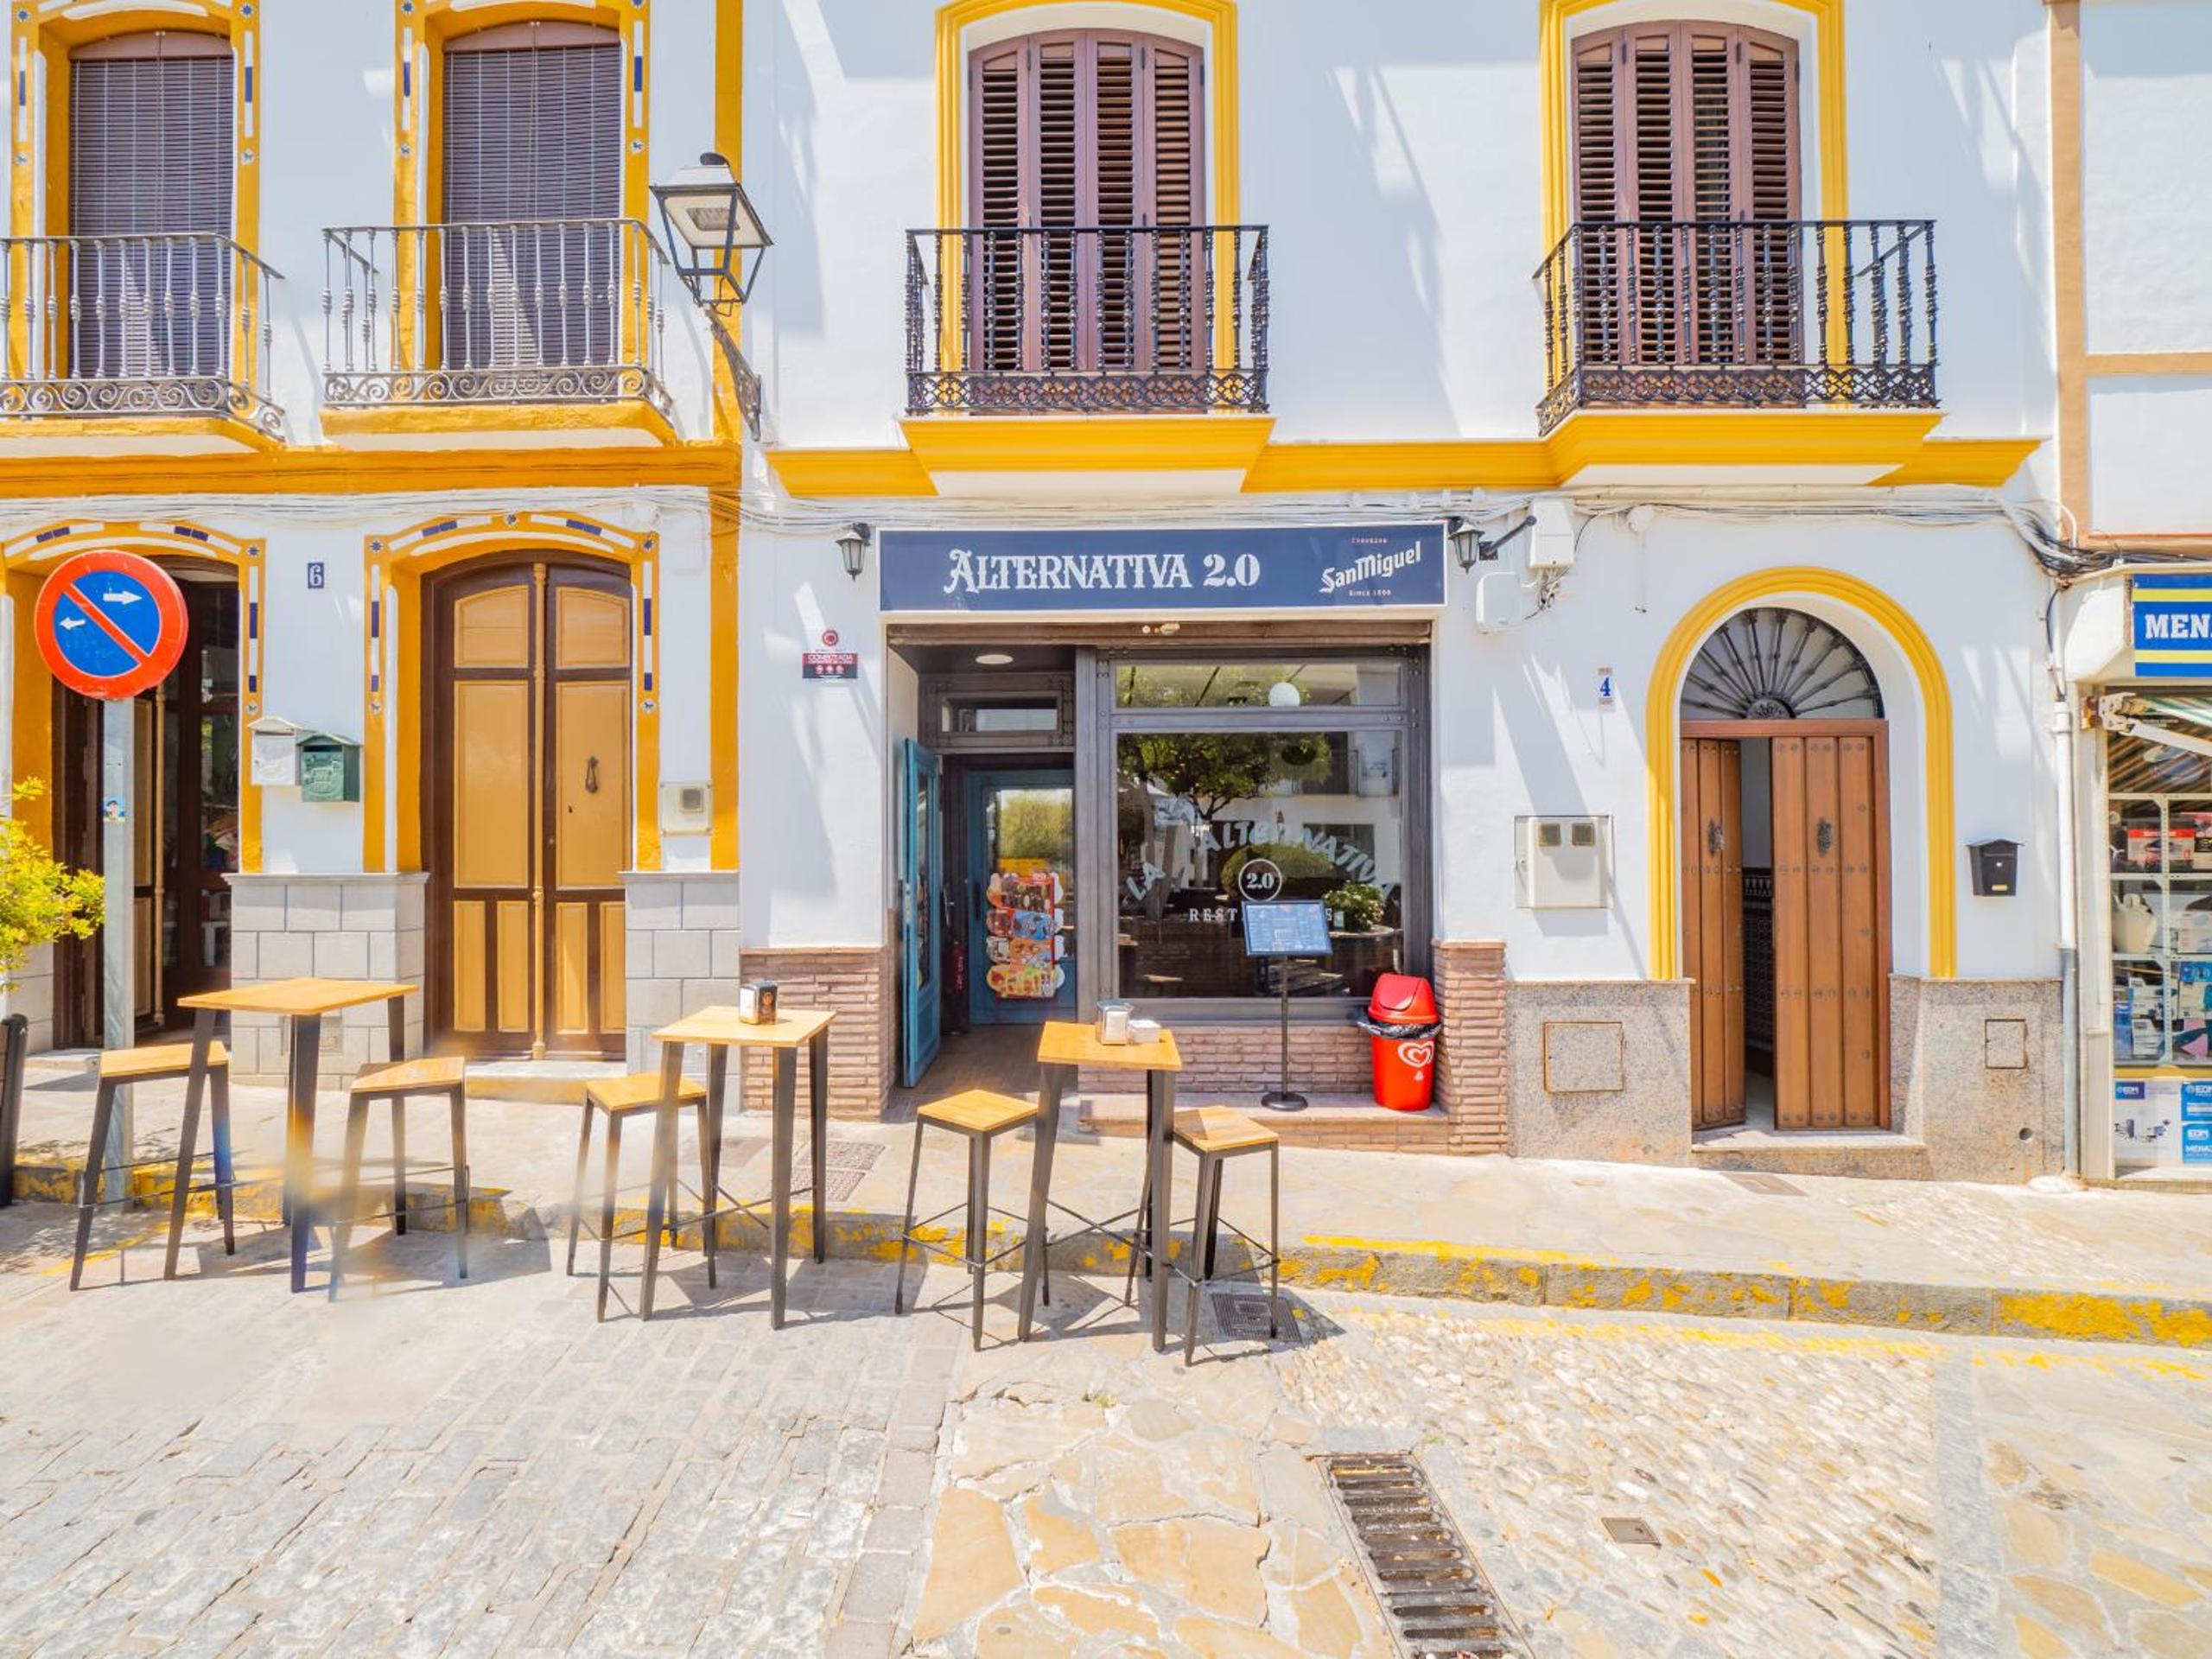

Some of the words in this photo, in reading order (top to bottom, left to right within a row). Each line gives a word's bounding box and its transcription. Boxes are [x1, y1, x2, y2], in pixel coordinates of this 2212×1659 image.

[309, 564, 322, 586] 6
[944, 549, 1192, 594] ALTERNATIVA
[1203, 554, 1260, 587] 2.0
[2145, 613, 2212, 639] MEN
[1599, 677, 1611, 696] 4
[1126, 861, 1166, 900] LA
[1246, 872, 1275, 890] 2.0
